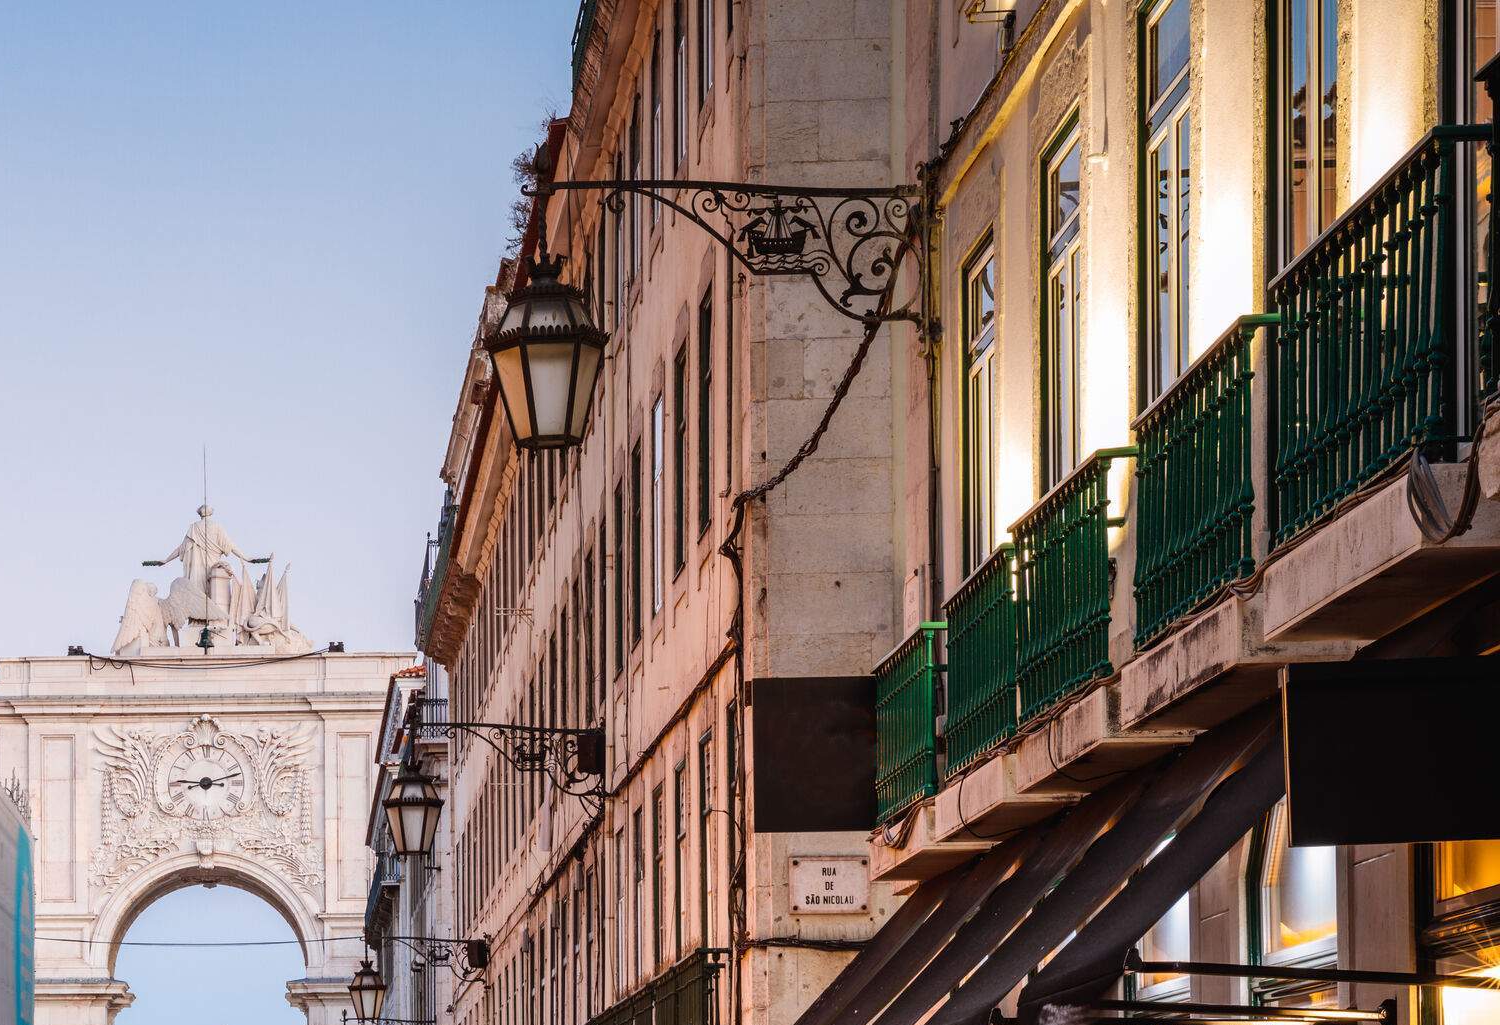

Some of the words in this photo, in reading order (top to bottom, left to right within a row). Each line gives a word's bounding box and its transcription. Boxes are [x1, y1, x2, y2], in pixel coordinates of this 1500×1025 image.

[822, 868, 836, 876] RUA
[825, 882, 834, 890] DE
[805, 894, 820, 905] SÃO
[823, 895, 854, 905] NICOLAU
